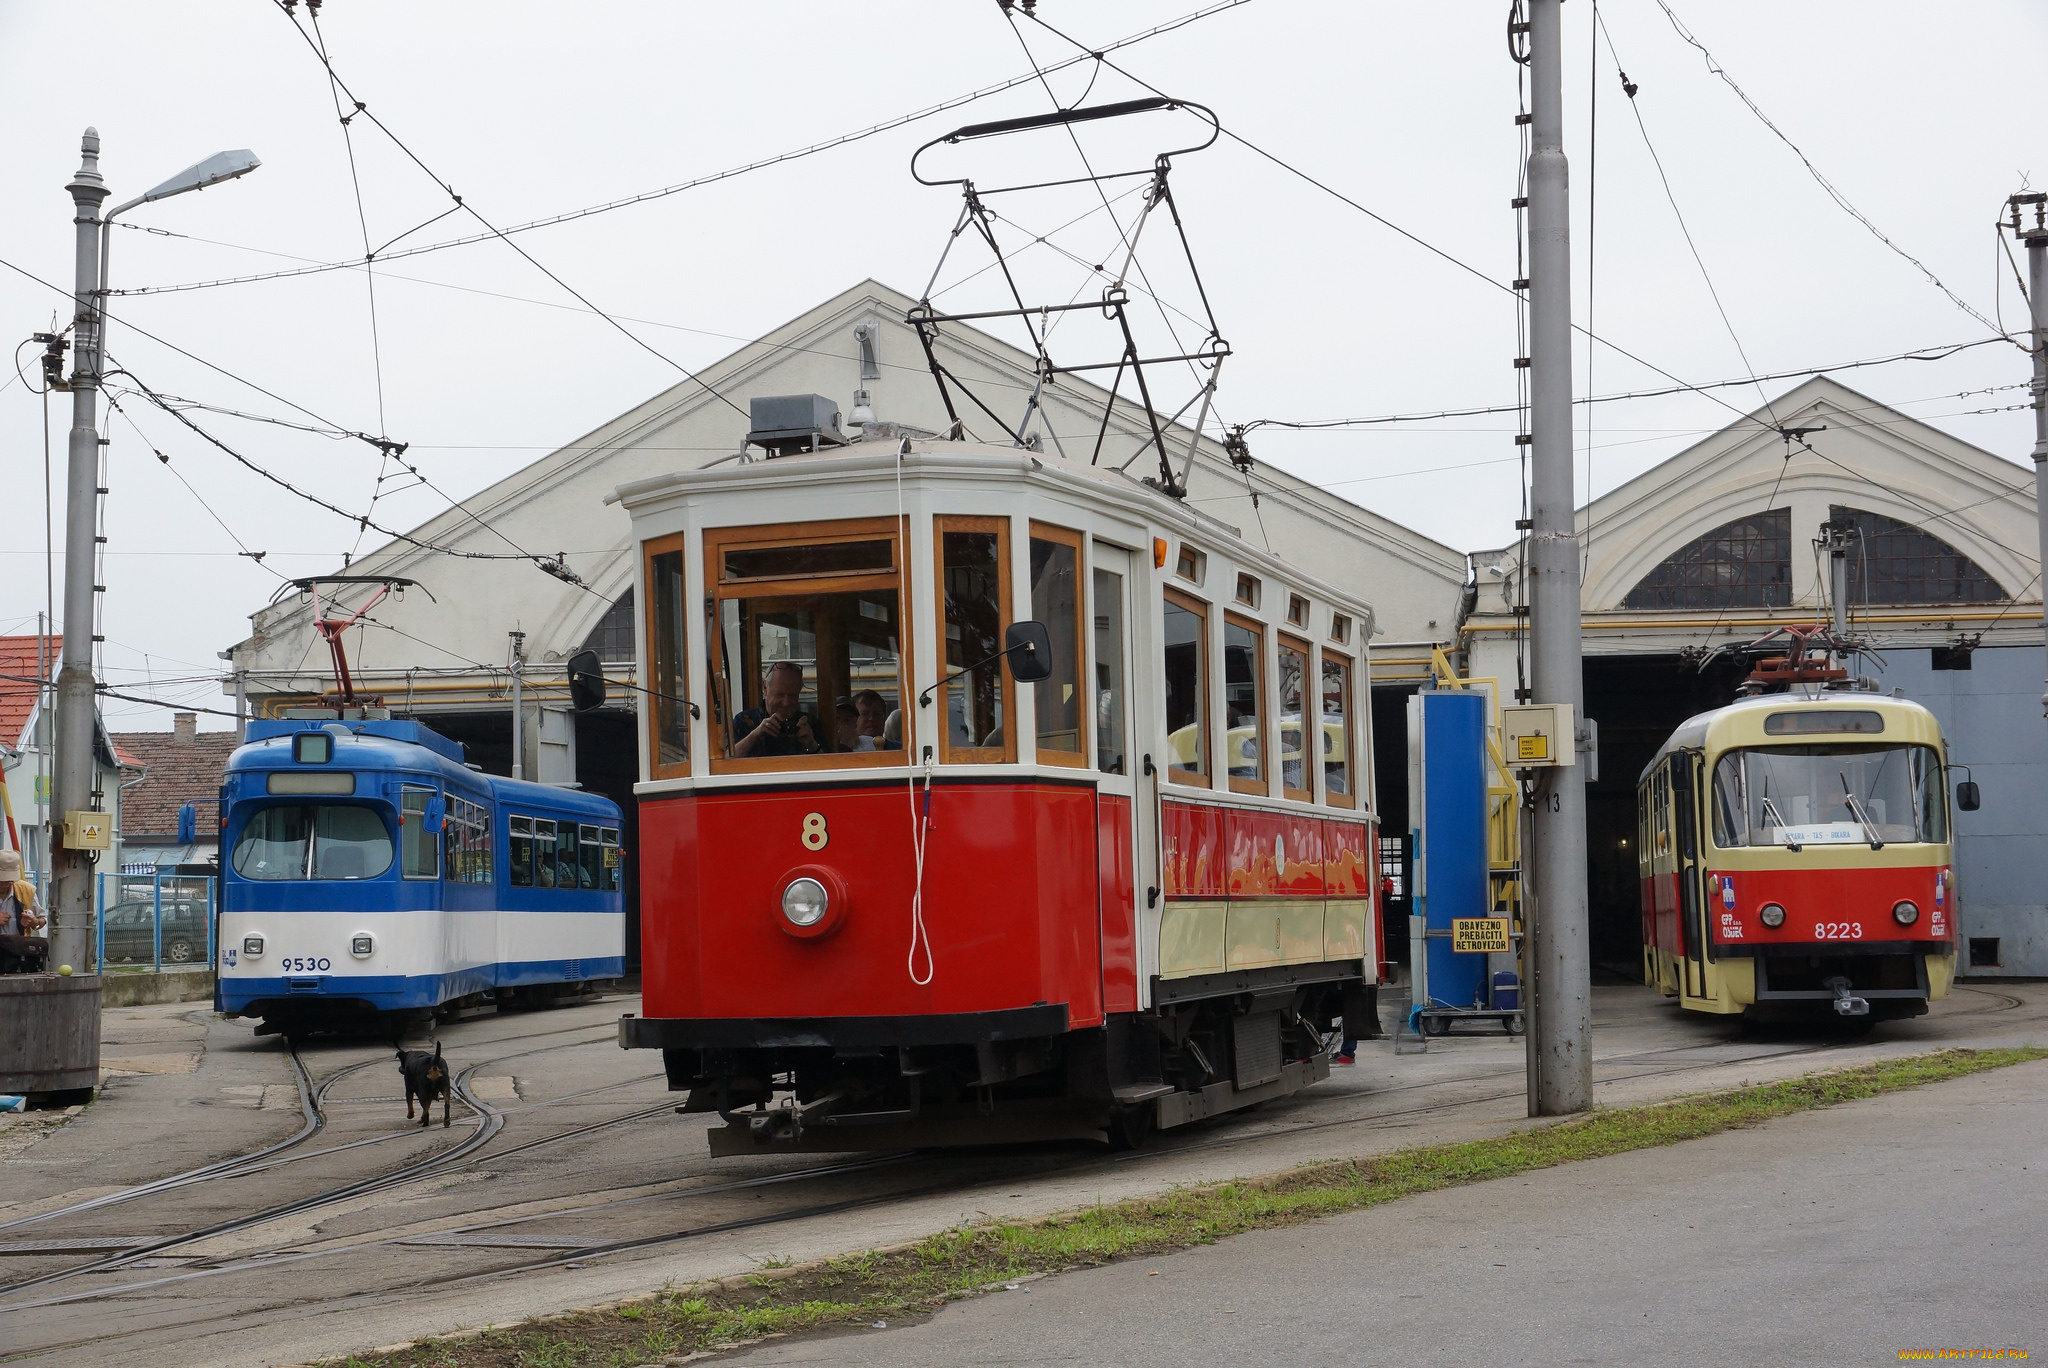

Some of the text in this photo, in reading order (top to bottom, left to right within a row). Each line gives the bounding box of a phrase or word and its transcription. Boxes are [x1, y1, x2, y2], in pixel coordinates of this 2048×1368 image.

[1545, 792, 1560, 813] 13
[801, 811, 829, 851] 8
[1459, 921, 1501, 930] OBAVEZNO
[1815, 922, 1863, 939] 8223
[1459, 931, 1502, 940] PREBACITI
[1456, 941, 1506, 950] RETROVIZOR
[282, 957, 331, 972] 9530
